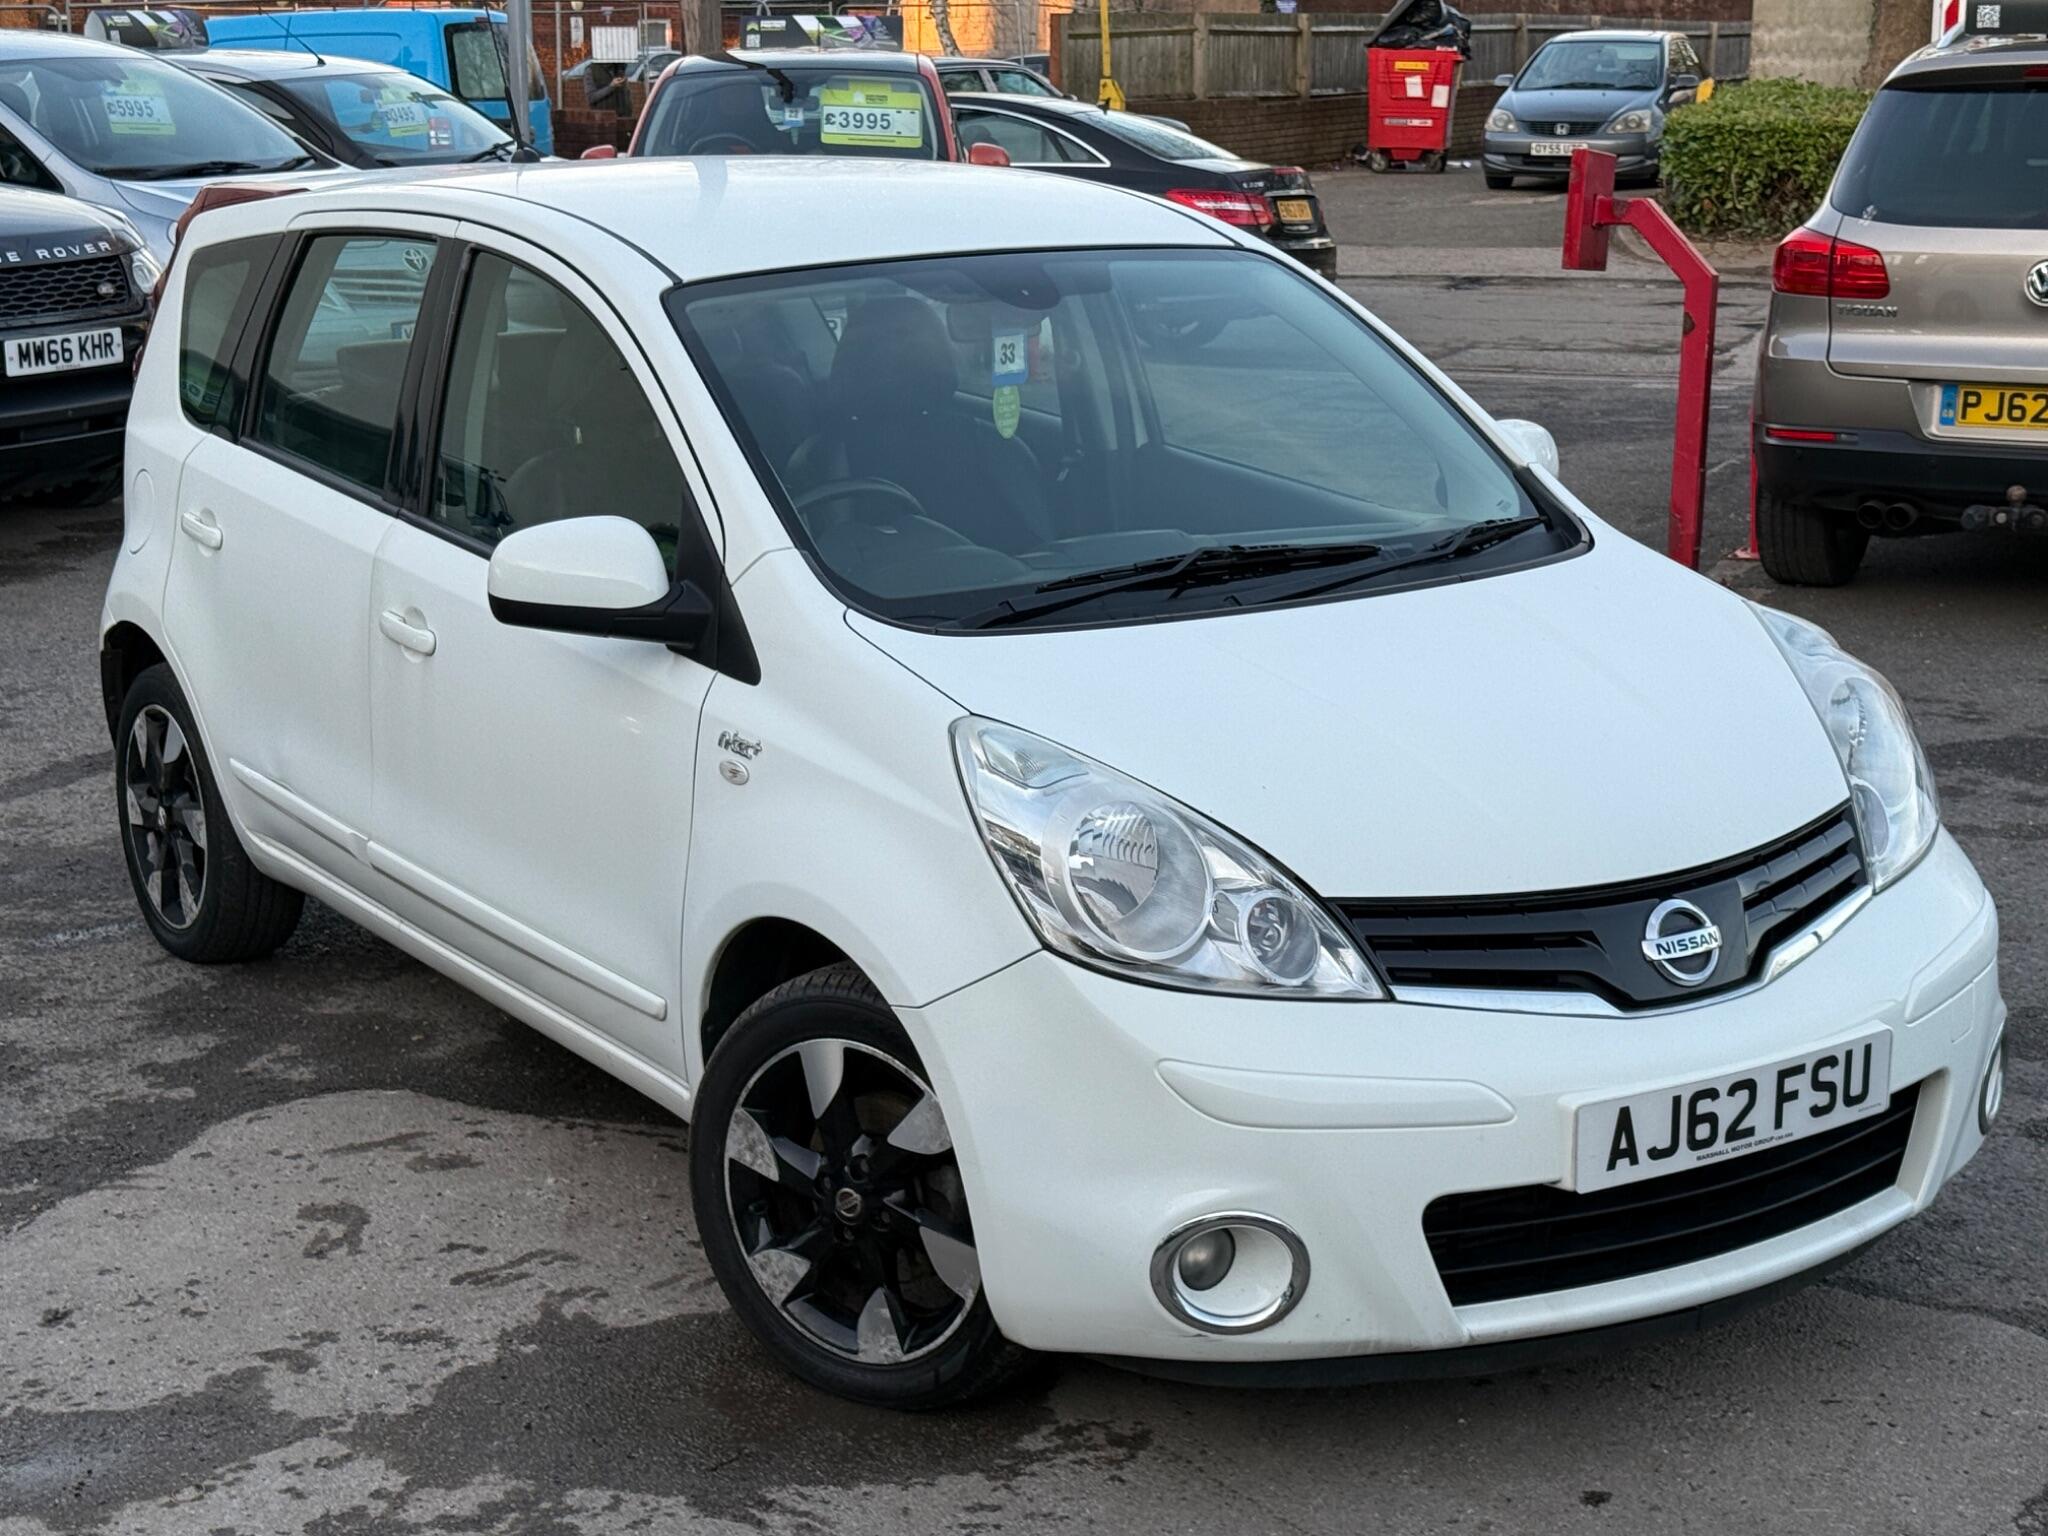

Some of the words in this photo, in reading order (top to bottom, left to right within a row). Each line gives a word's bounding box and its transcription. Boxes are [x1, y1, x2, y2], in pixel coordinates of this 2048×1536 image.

[107, 100, 154, 118] £5995
[824, 111, 892, 130] £3995
[35, 241, 112, 260] ROVER
[1836, 303, 1898, 318] TIGUAN
[17, 337, 74, 369] MW66
[77, 332, 115, 361] KHR
[999, 342, 1016, 365] 33
[1960, 390, 2048, 423] PJ62
[1655, 931, 1719, 956] NISSAN
[1606, 1077, 1758, 1172] AJ62
[1773, 1042, 1873, 1131] FSU
[1731, 1141, 1753, 1153] MOTOR
